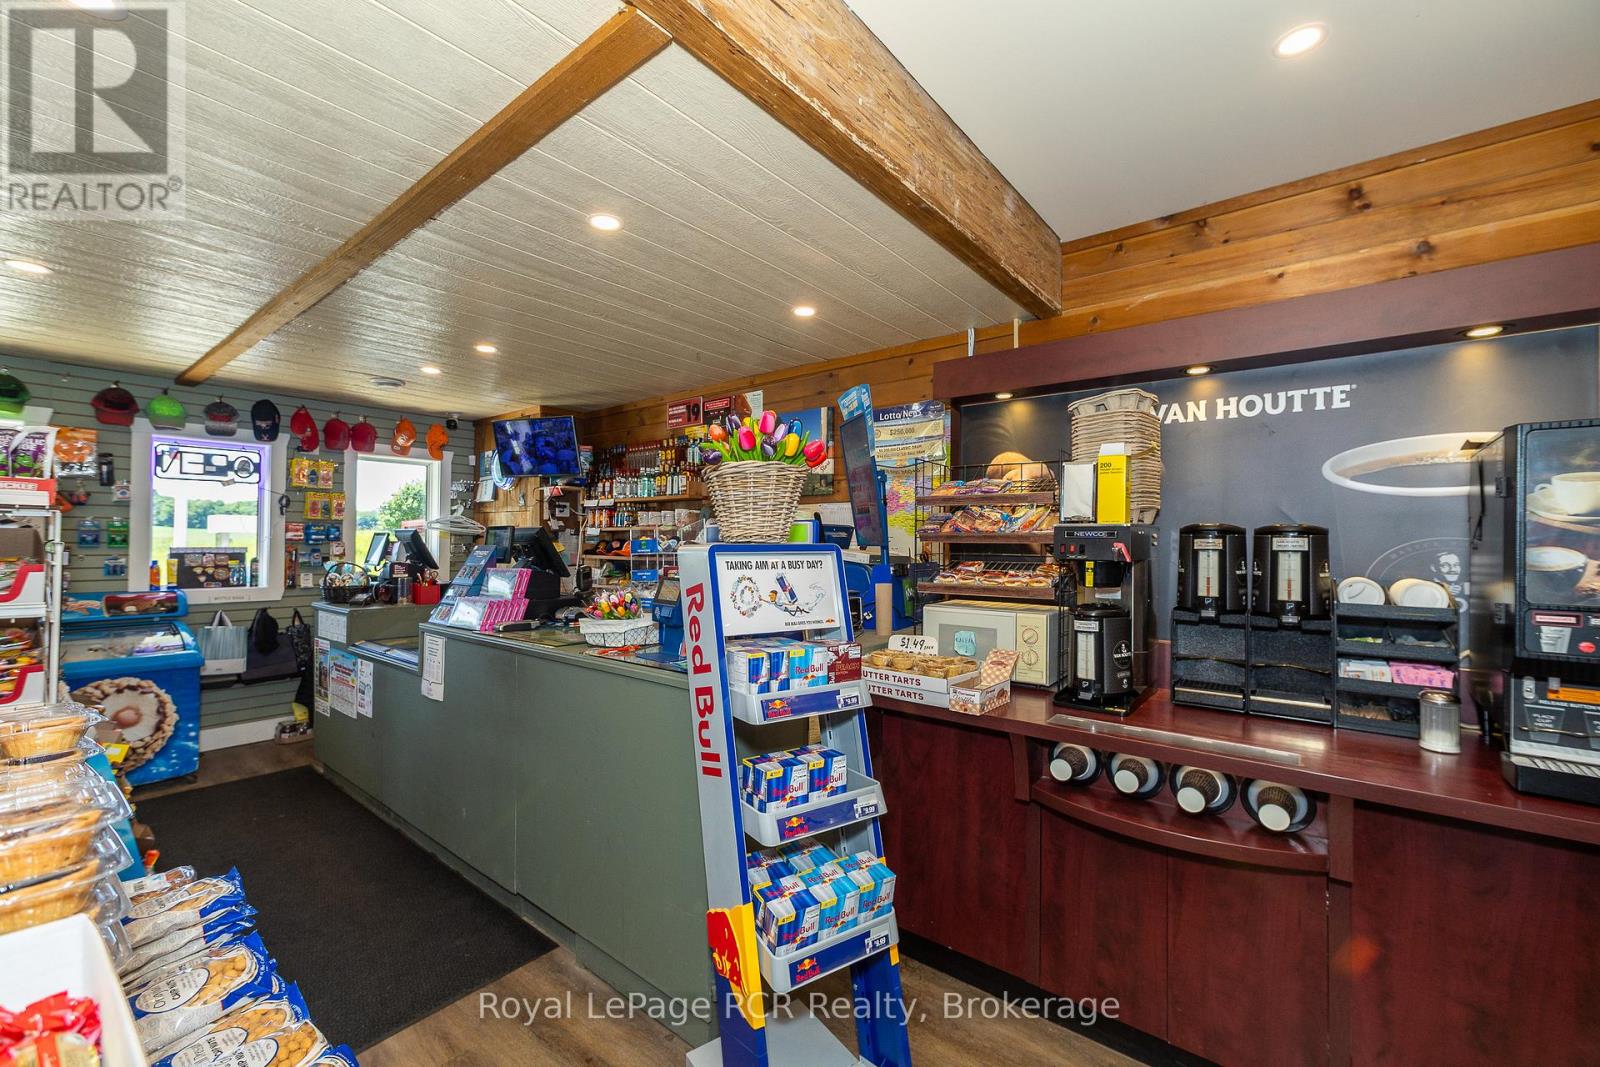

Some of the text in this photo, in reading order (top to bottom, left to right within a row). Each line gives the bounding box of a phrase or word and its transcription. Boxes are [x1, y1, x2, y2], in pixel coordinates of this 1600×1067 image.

[1216, 384, 1351, 419] HOUTTE
[686, 403, 700, 422] 19
[879, 413, 902, 421] Lotto
[725, 560, 823, 571] TAKING AIM AT A BUSY DAY?
[795, 663, 824, 674] Red Bull
[686, 583, 723, 778] Red Bull
[863, 670, 921, 687] UTTER TARTS
[896, 689, 925, 701] TARTS
[815, 773, 843, 787] Red Bull
[773, 782, 804, 797] Red Bull
[859, 856, 874, 866] Bull
[807, 869, 839, 883] Red Bull
[783, 882, 800, 893] Bull
[863, 892, 891, 908] Red Bull
[825, 906, 855, 924] Red Bull
[783, 922, 815, 940] Red Bull
